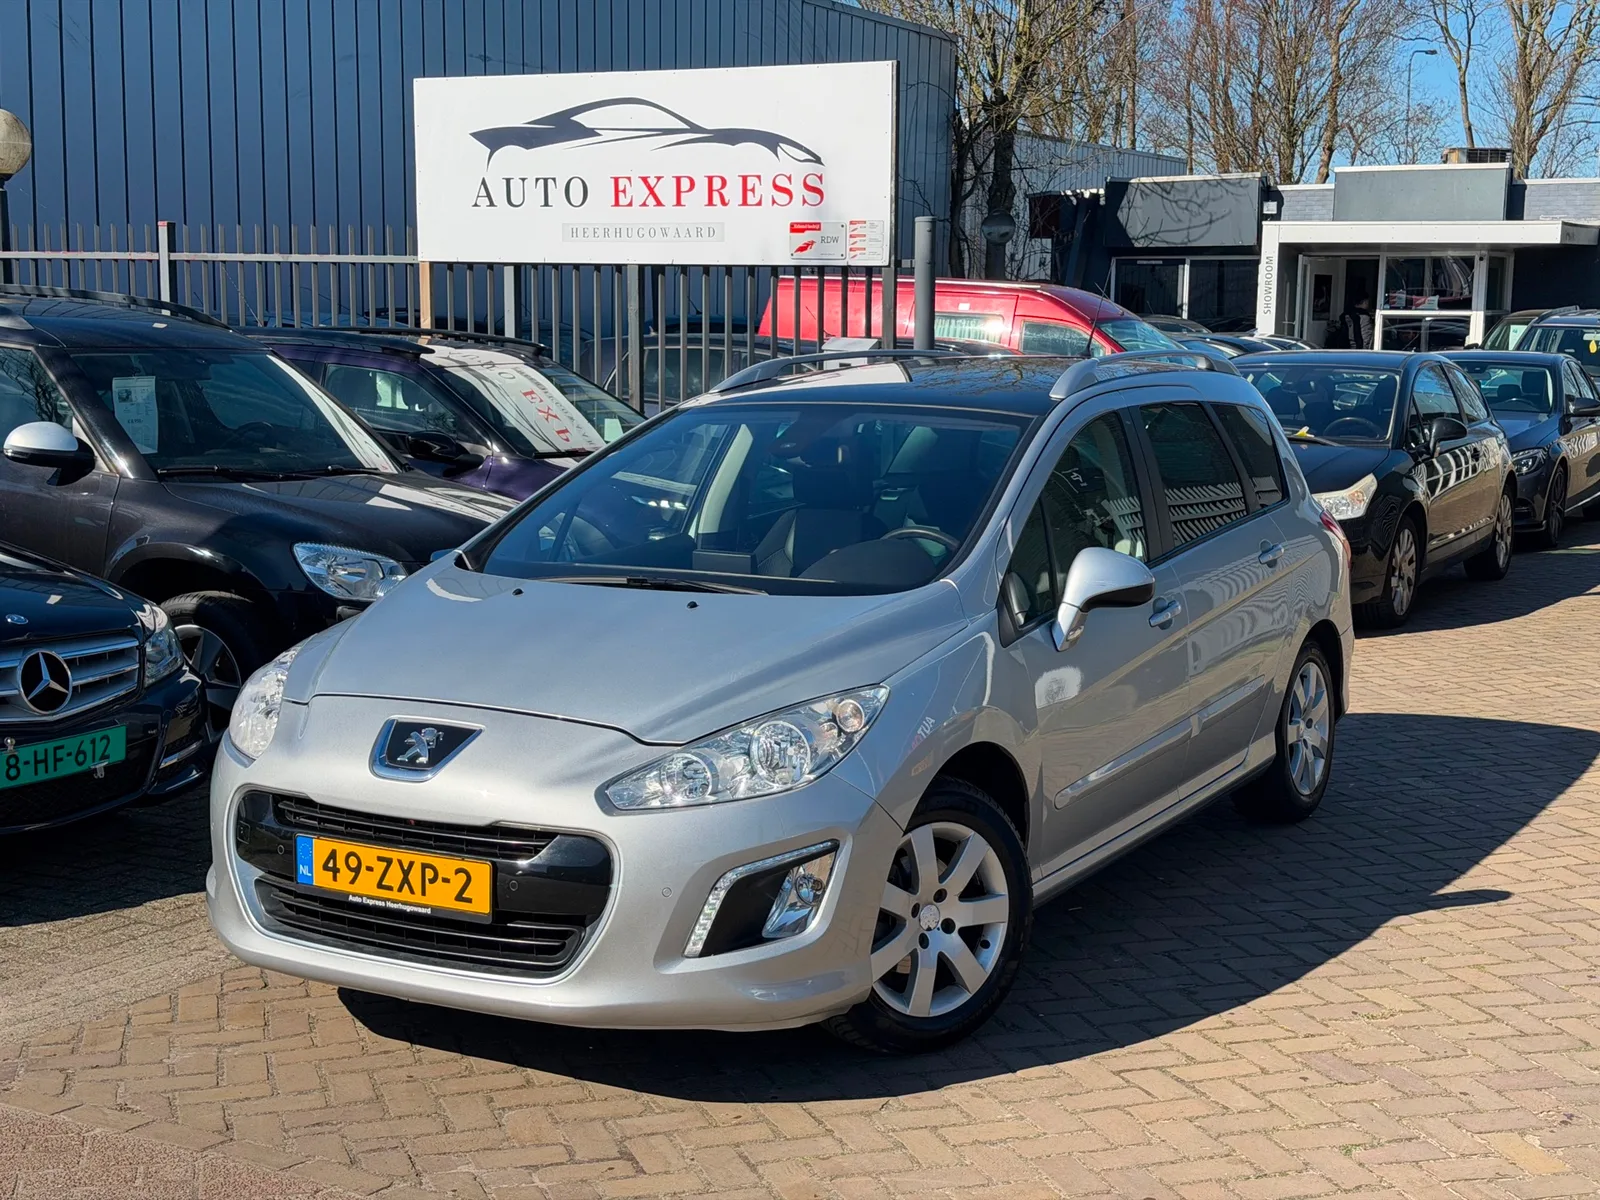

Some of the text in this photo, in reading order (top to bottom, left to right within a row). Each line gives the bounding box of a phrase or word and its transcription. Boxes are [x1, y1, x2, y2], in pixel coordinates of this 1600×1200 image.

[471, 173, 826, 208] AUTO EXPRESS
[570, 226, 716, 239] HEERHUGOWAARD
[820, 235, 840, 244] RDW
[1263, 256, 1274, 315] SHOWROOM
[299, 849, 473, 904] NL 49-ZXP-2
[348, 894, 432, 914] Auto Express Heerhugowaard
